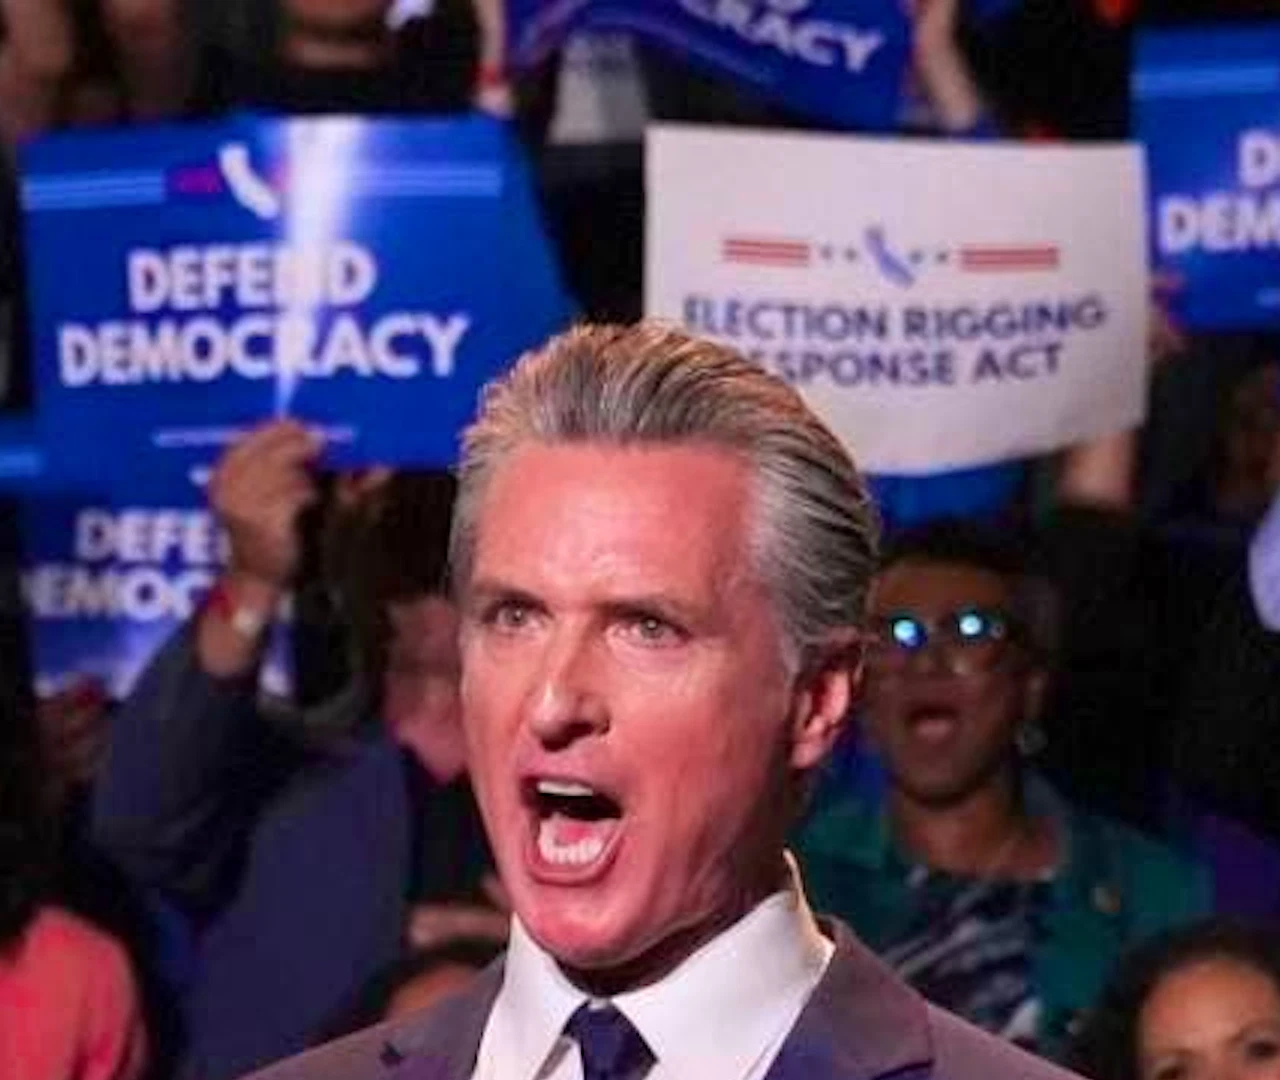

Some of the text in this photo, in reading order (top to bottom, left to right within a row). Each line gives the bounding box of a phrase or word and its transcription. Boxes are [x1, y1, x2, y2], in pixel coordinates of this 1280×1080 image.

[684, 293, 1107, 344] ELECTION RIGGING
[57, 312, 471, 388] DEMOCRACY
[973, 342, 1065, 380] ACT
